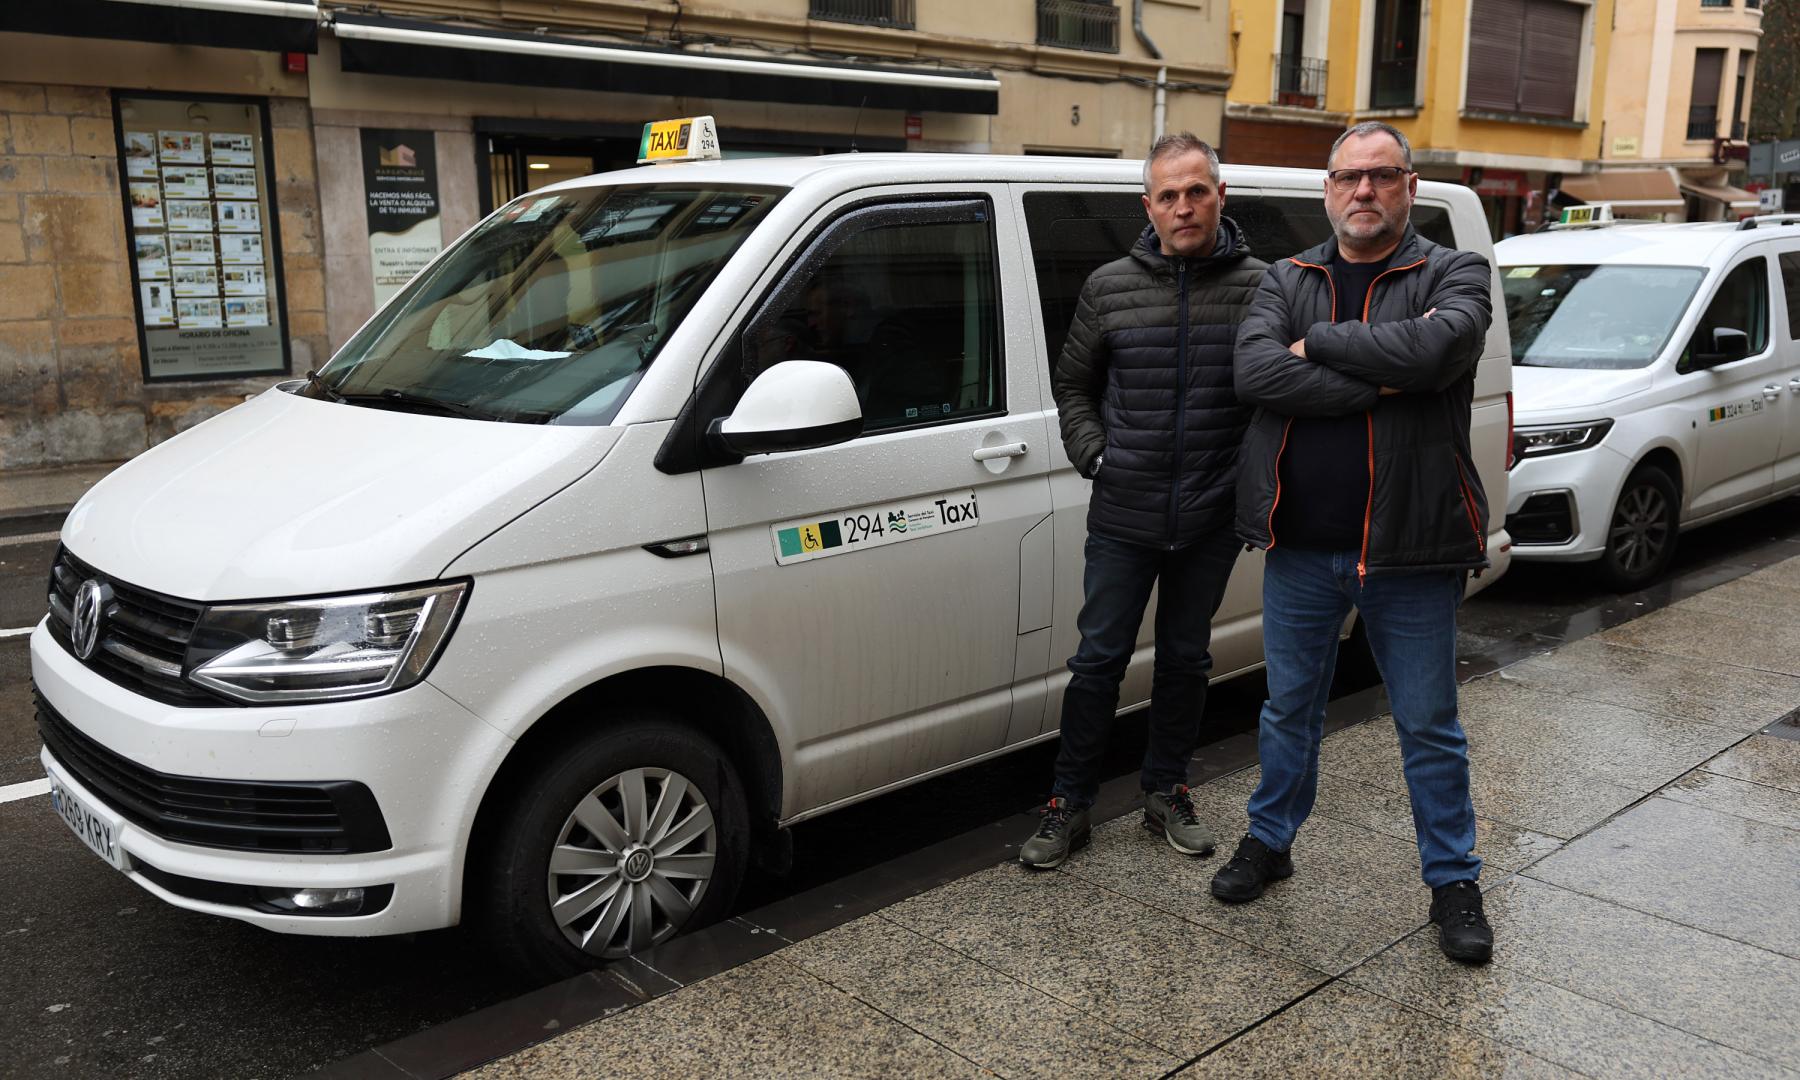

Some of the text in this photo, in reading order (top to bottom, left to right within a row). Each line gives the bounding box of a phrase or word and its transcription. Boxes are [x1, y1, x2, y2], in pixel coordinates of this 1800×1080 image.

[1071, 104, 1080, 126] 3
[650, 129, 678, 152] TAXI
[701, 140, 715, 150] 294
[369, 191, 400, 199] HACEMOS
[400, 190, 414, 199] MÁS
[1571, 208, 1591, 221] TAXI
[178, 331, 211, 339] HORARIO
[222, 329, 250, 337] OFICINA
[843, 494, 978, 544] 294 Taxi
[84, 810, 115, 861] KRX
